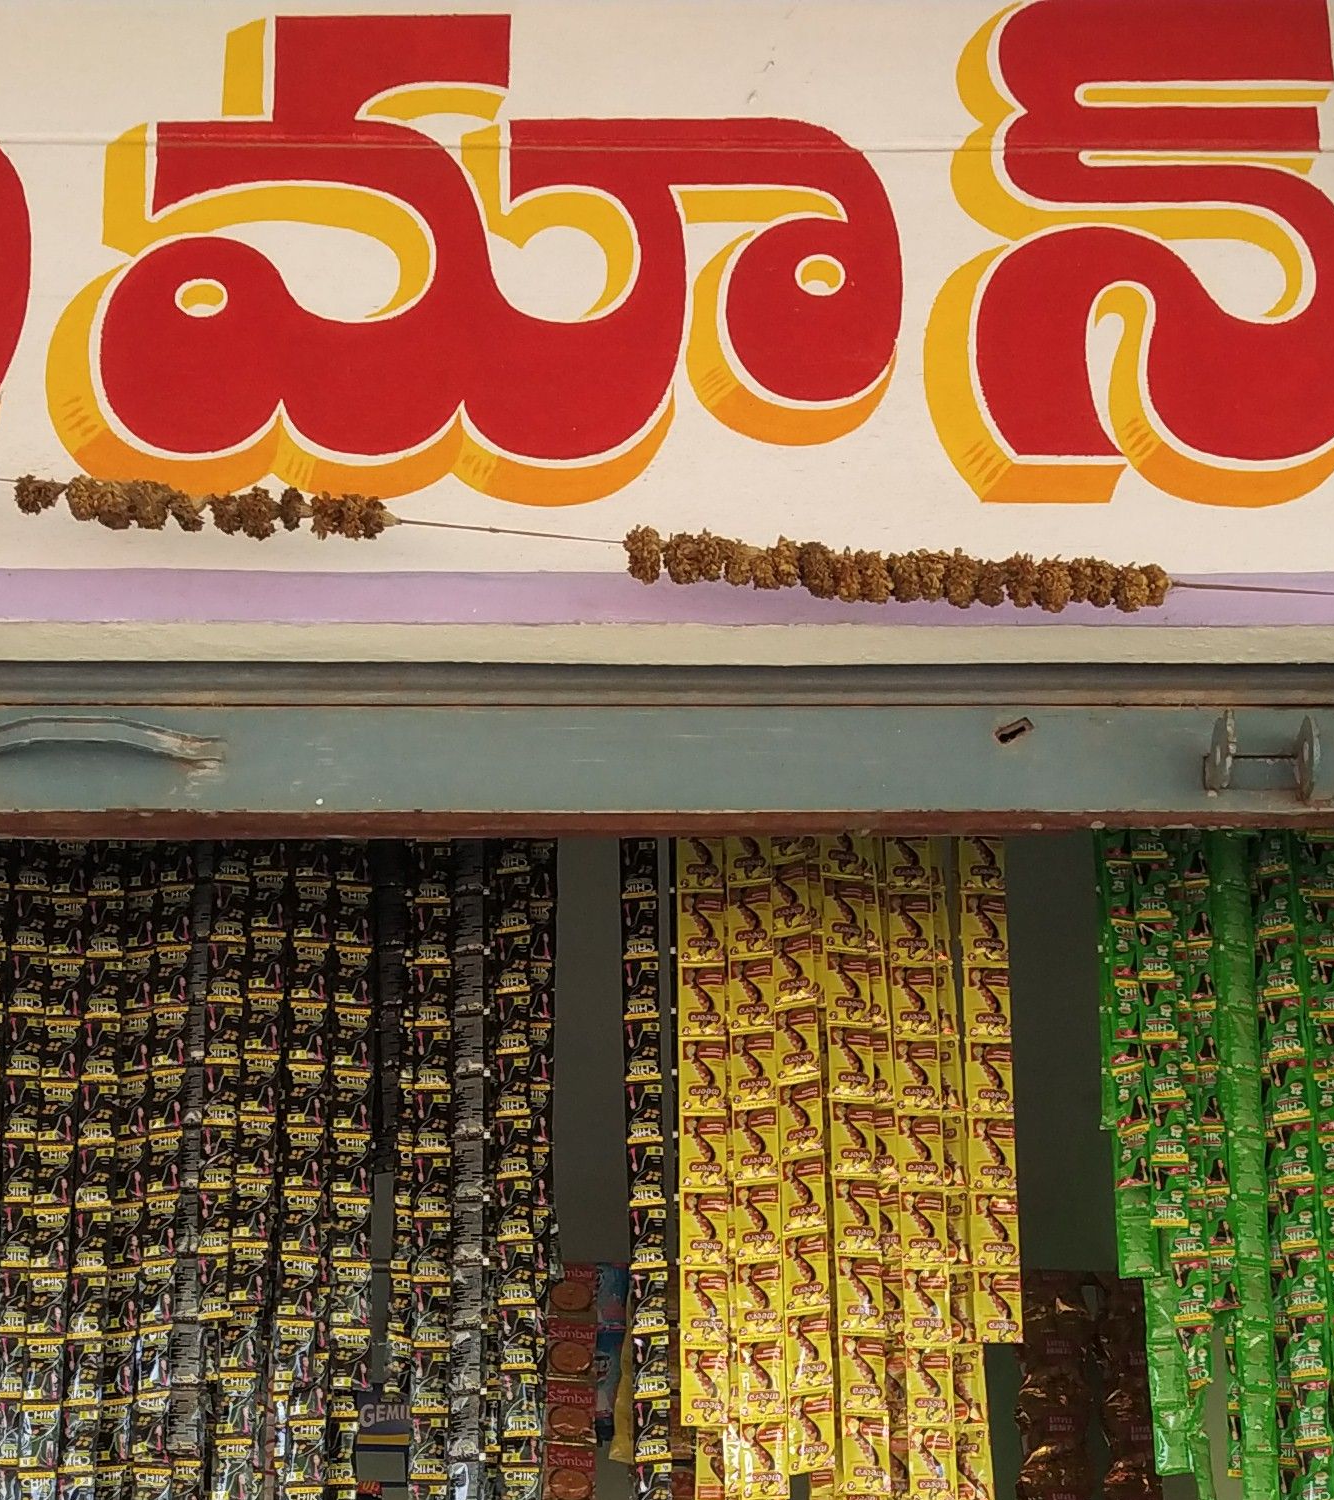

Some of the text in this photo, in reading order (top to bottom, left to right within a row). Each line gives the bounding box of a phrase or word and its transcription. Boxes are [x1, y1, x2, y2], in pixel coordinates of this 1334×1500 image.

[283, 1261, 314, 1275] CHIK
[337, 1266, 367, 1280] CHIK
[33, 1277, 62, 1290] CHIK
[280, 1325, 312, 1340] CHIK
[548, 1323, 596, 1342] Sambar
[548, 1387, 596, 1406] Sambar
[291, 1424, 322, 1437] CHIK
[547, 1452, 595, 1471] Sambar
[21, 1478, 50, 1490] CHIK
[504, 1471, 535, 1484] CHIK
